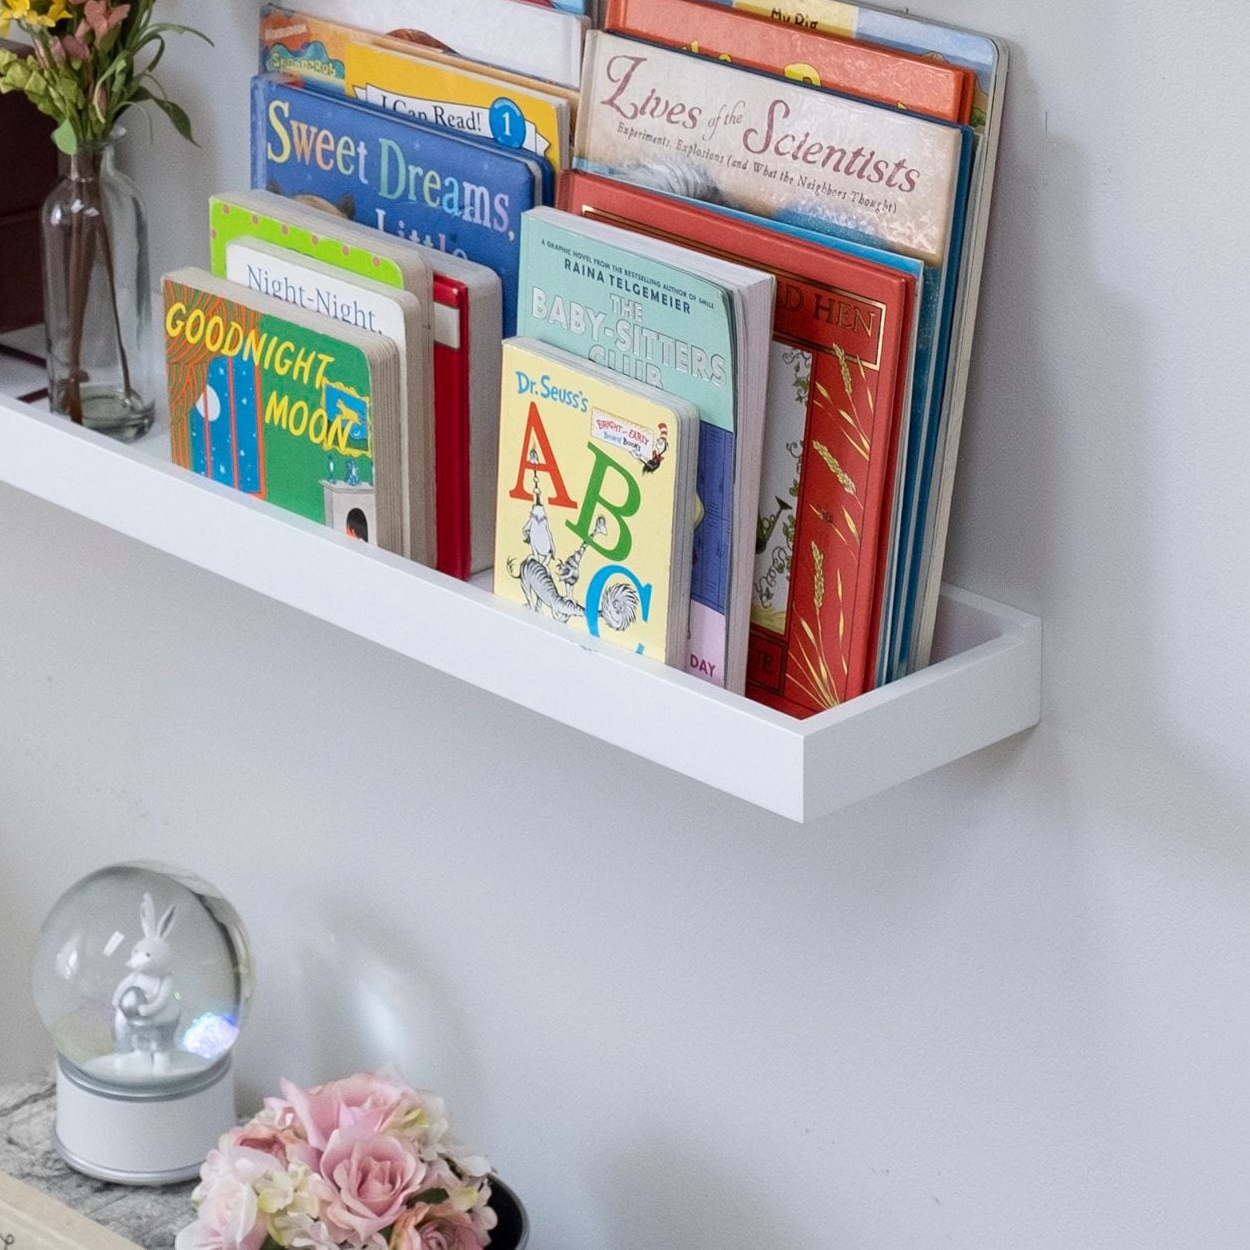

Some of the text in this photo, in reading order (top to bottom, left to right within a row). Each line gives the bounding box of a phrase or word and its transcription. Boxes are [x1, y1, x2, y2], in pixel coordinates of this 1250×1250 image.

[432, 105, 482, 132] Read!
[502, 111, 511, 137] 1
[600, 54, 921, 193] Lives of the Scientists
[266, 100, 369, 185] Sweet
[377, 137, 515, 242] Dreams,
[617, 121, 898, 215] Experiments, Explosions (and What the Neighbors Thought)
[547, 241, 571, 256] GRAPHIC
[573, 250, 592, 264] NOVEL
[594, 256, 611, 270] FROM
[612, 263, 623, 274] THE
[624, 269, 661, 288] BESTSELLING
[662, 282, 687, 298] AUTHOR
[688, 291, 697, 301] OF
[699, 295, 715, 310] SMILE
[564, 258, 691, 315] RAINA TELGEMEIER
[610, 292, 643, 323] THE
[813, 293, 876, 338] HEN
[165, 301, 335, 390] GOODNIGHT
[531, 286, 727, 388] BABY-SITTERS
[515, 371, 589, 413] Dr. Seuss's
[265, 390, 358, 450] MOON
[596, 418, 622, 434] BRIGHT
[628, 429, 650, 446] EARLY
[603, 430, 641, 452] Board Books
[690, 653, 716, 678] DAY
